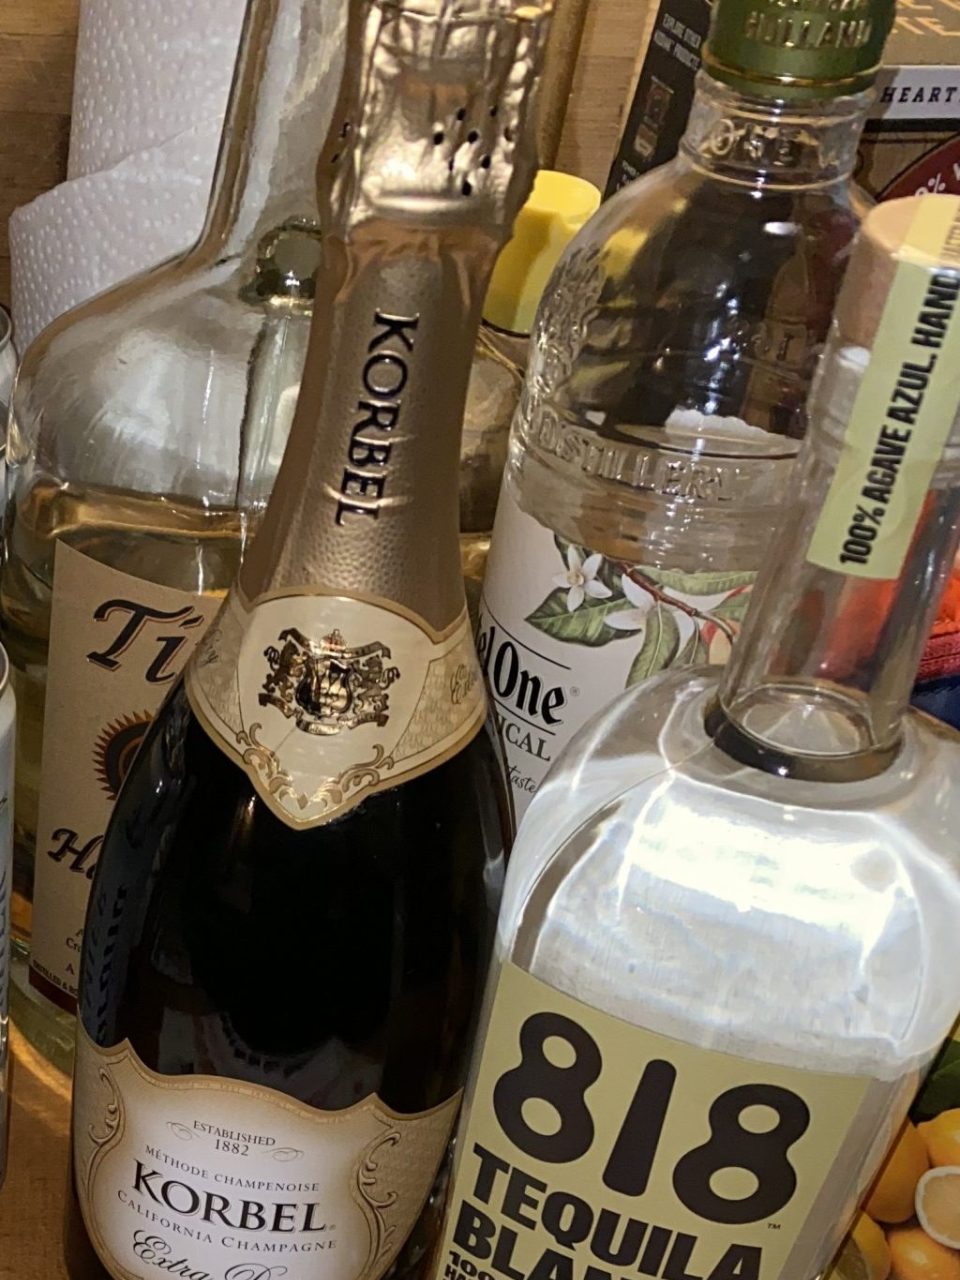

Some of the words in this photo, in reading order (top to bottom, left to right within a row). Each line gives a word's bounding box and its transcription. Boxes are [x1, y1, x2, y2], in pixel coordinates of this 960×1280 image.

[880, 87, 959, 103] HEART
[336, 309, 419, 526] KORBEL
[887, 353, 938, 425] AZUL.
[861, 424, 912, 504] AGAVE
[840, 504, 886, 565] 100%
[494, 640, 565, 725] One
[192, 1119, 276, 1148] ESTABLISHED
[213, 1138, 251, 1158] 1882
[493, 1011, 811, 1225] 818
[131, 1158, 331, 1233] KORBEL
[213, 1172, 321, 1193] CHAMPENOISE
[117, 1188, 214, 1245] CALIFORNIA
[220, 1236, 338, 1254] CHAMPAGNE
